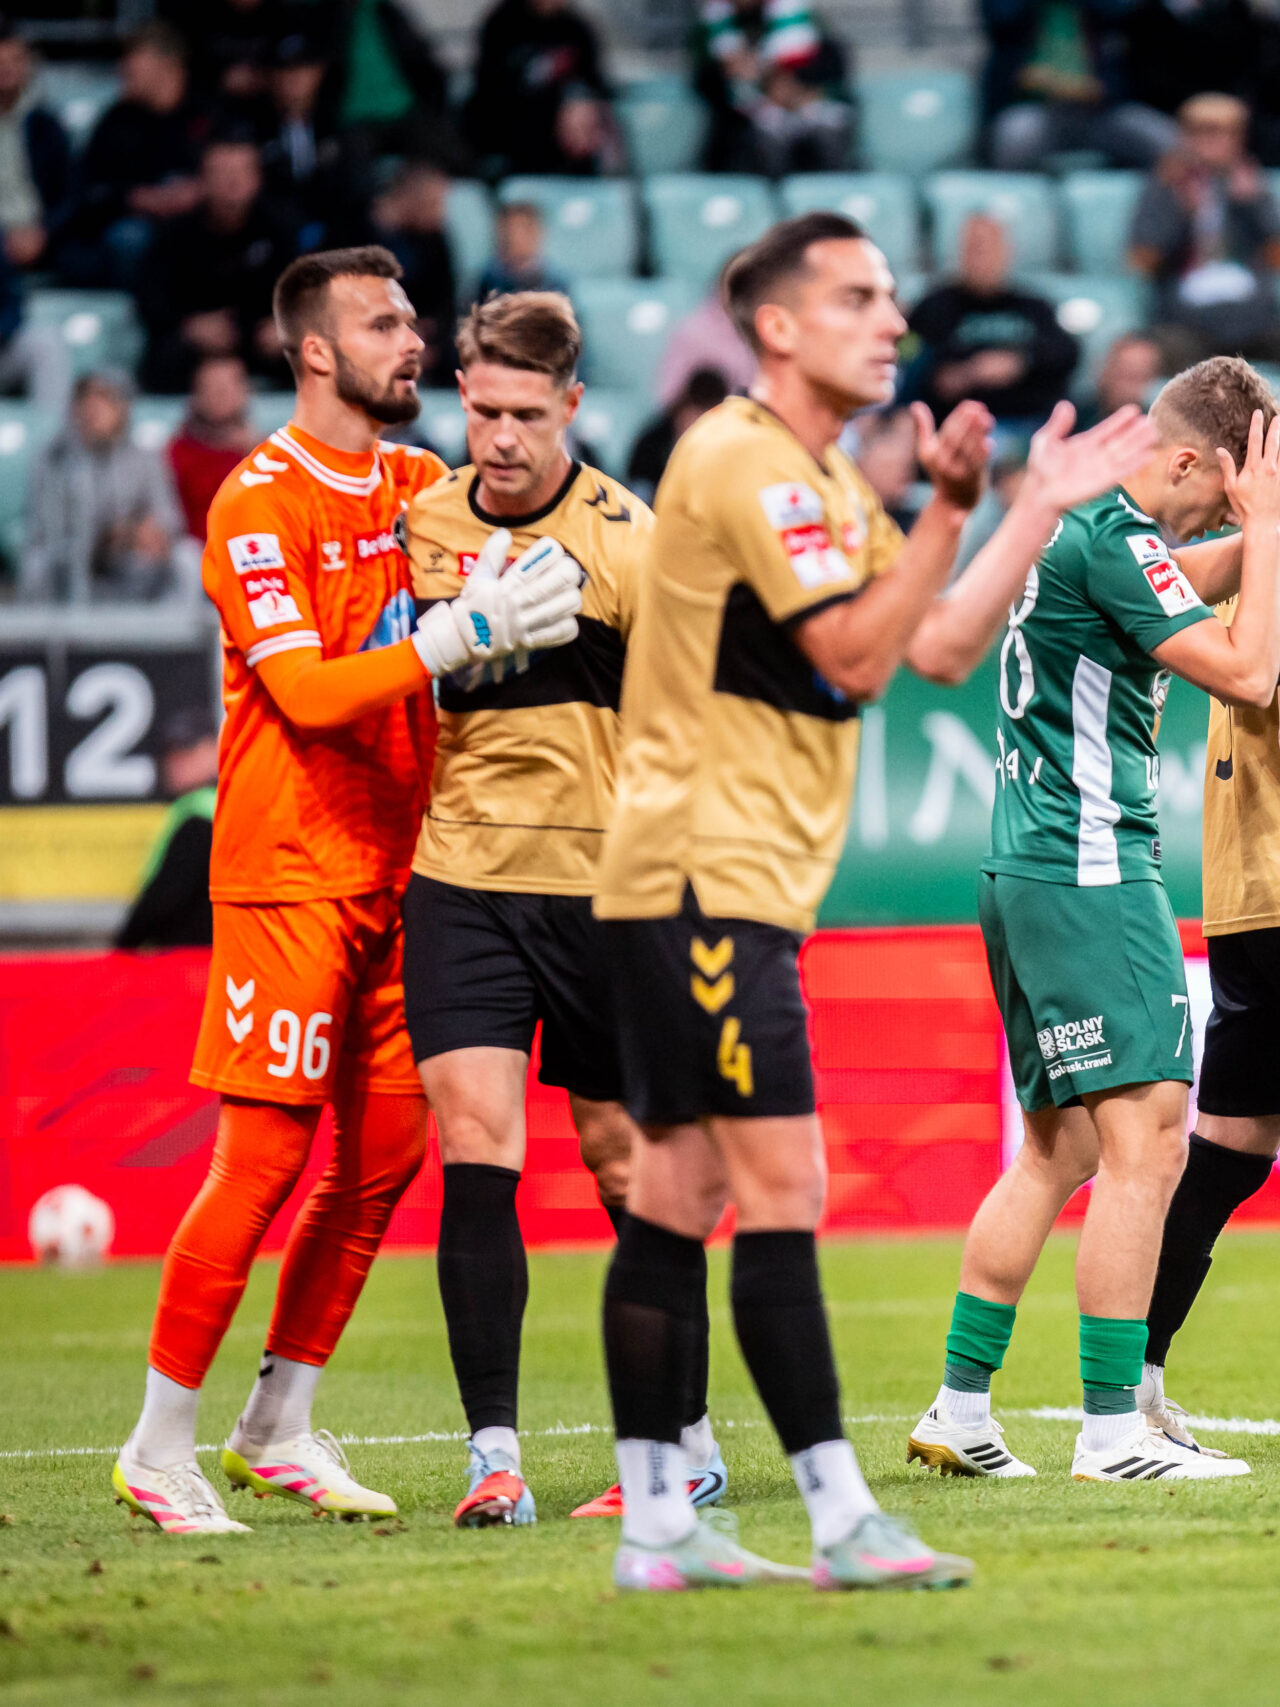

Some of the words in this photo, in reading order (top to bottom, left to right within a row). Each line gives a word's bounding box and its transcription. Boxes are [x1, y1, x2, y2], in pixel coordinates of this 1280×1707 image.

[0, 664, 157, 798] 12
[267, 1008, 332, 1080] 96
[716, 1016, 755, 1098] 4
[1053, 1015, 1103, 1039] DOLNY
